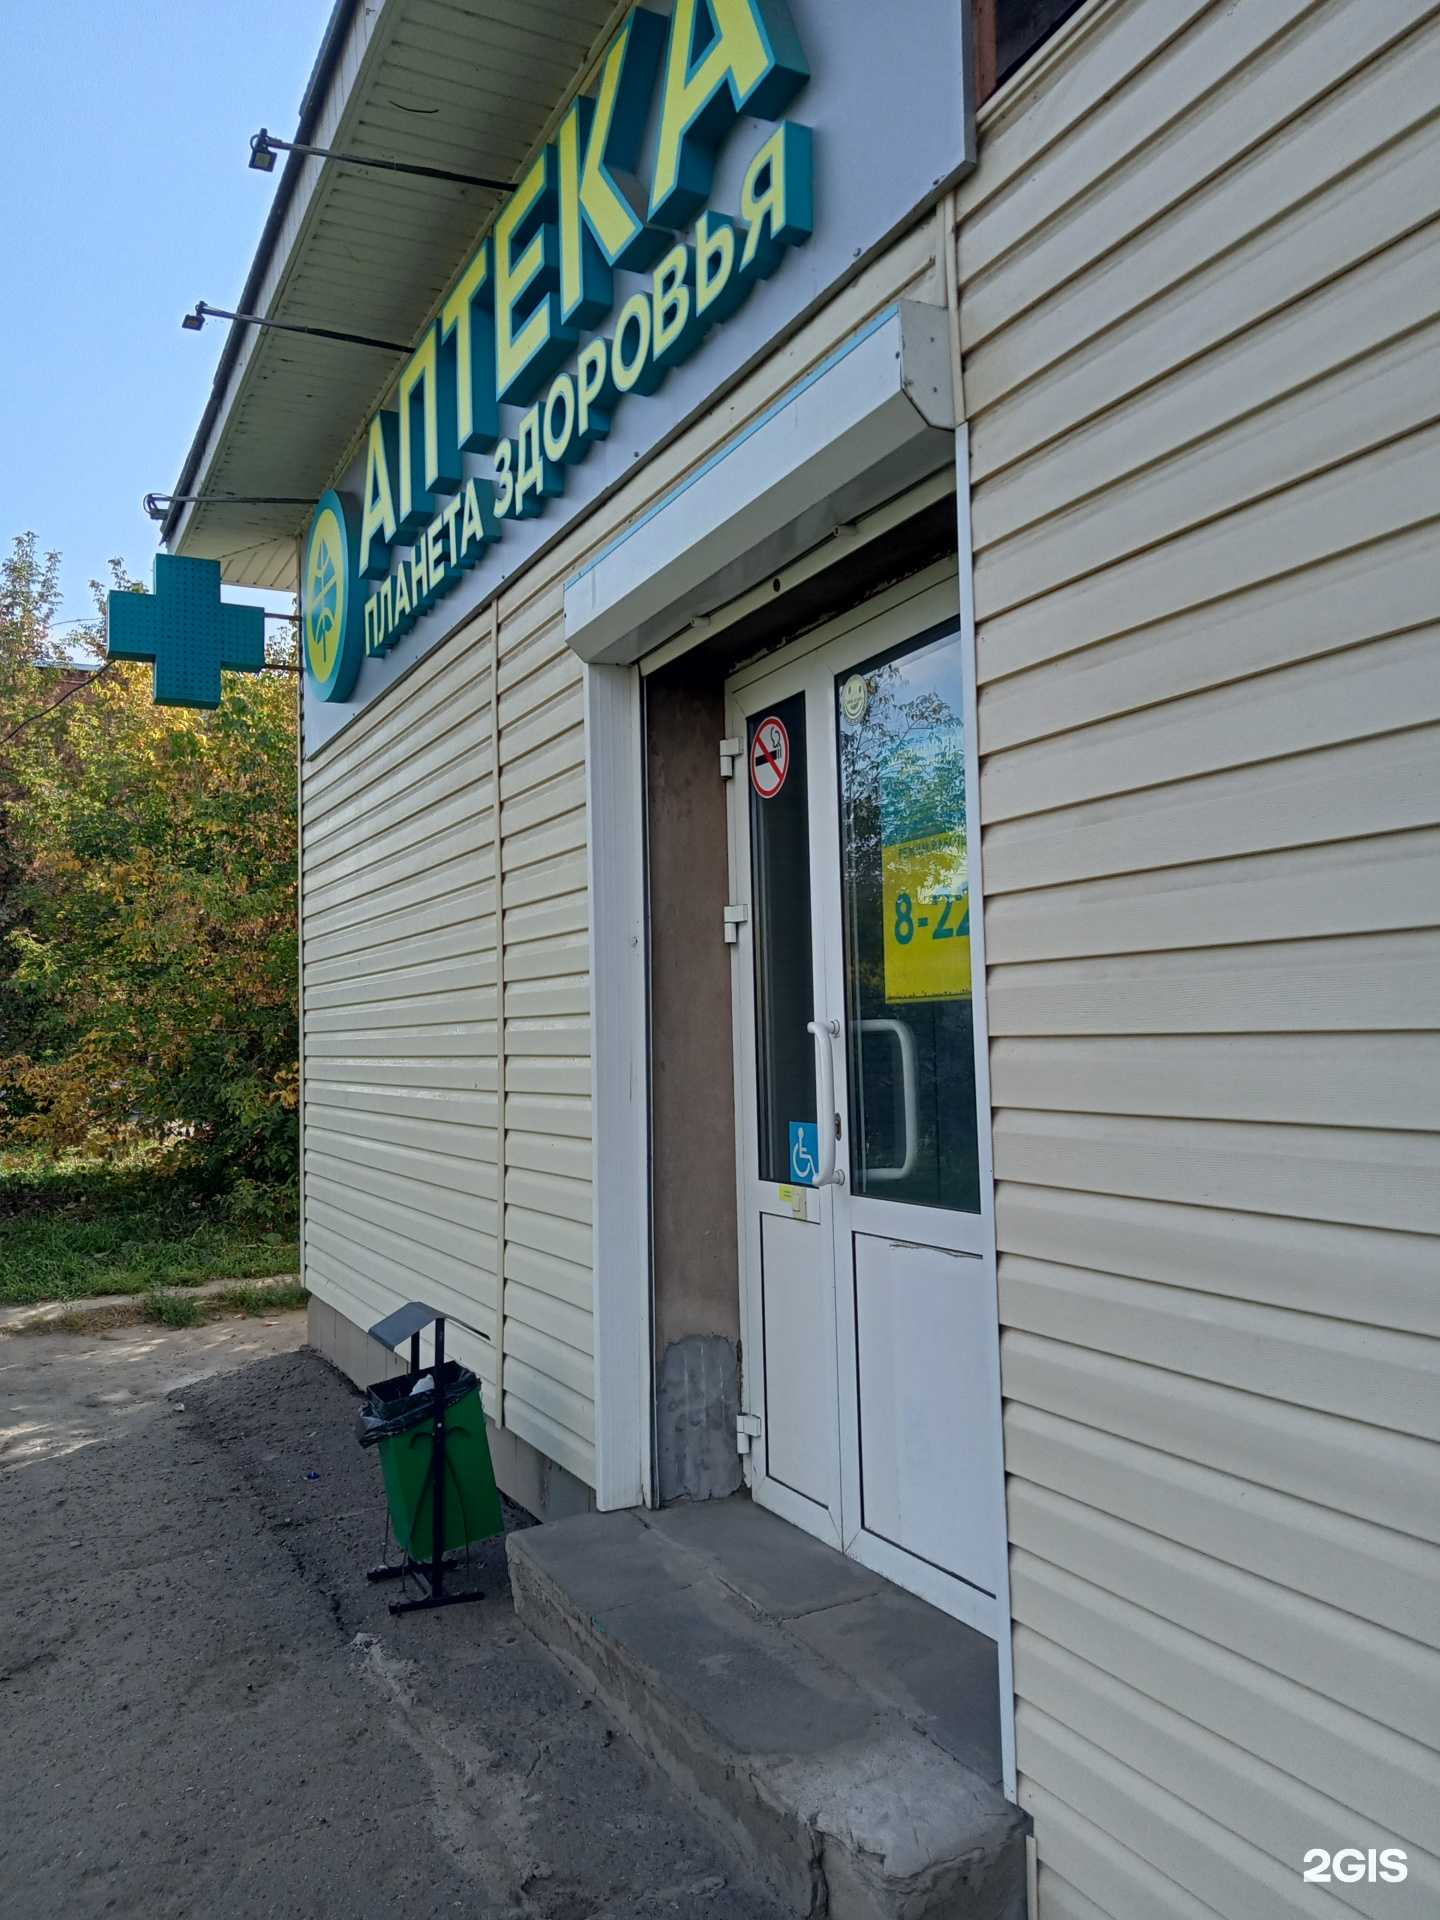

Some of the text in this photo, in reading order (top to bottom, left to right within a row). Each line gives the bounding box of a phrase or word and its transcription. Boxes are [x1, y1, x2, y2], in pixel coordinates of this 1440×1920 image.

[359, 0, 778, 577] АПТЕКА
[364, 121, 788, 657] ПЛАНЕТА ЗДОРОВЬЯ
